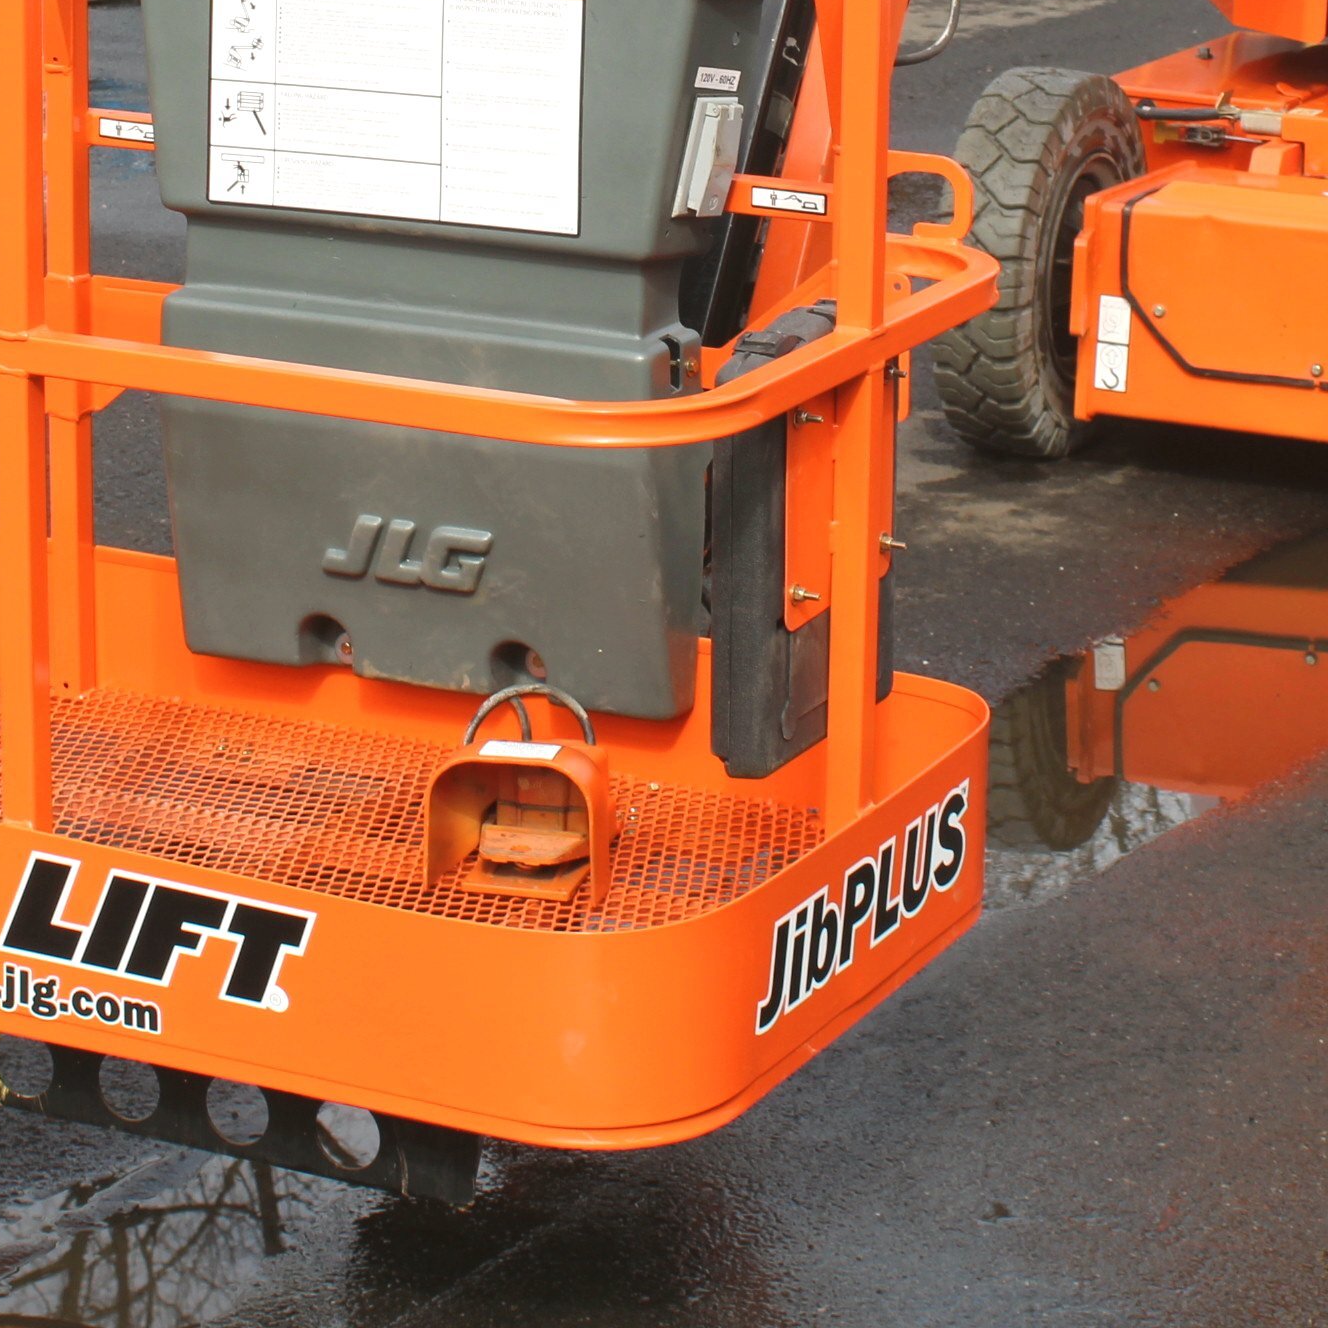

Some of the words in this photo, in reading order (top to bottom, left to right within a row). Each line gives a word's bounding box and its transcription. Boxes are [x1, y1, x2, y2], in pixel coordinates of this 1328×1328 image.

[700, 72, 715, 83] 120V
[321, 513, 494, 594] JLG
[755, 785, 968, 1036] JibPLUS
